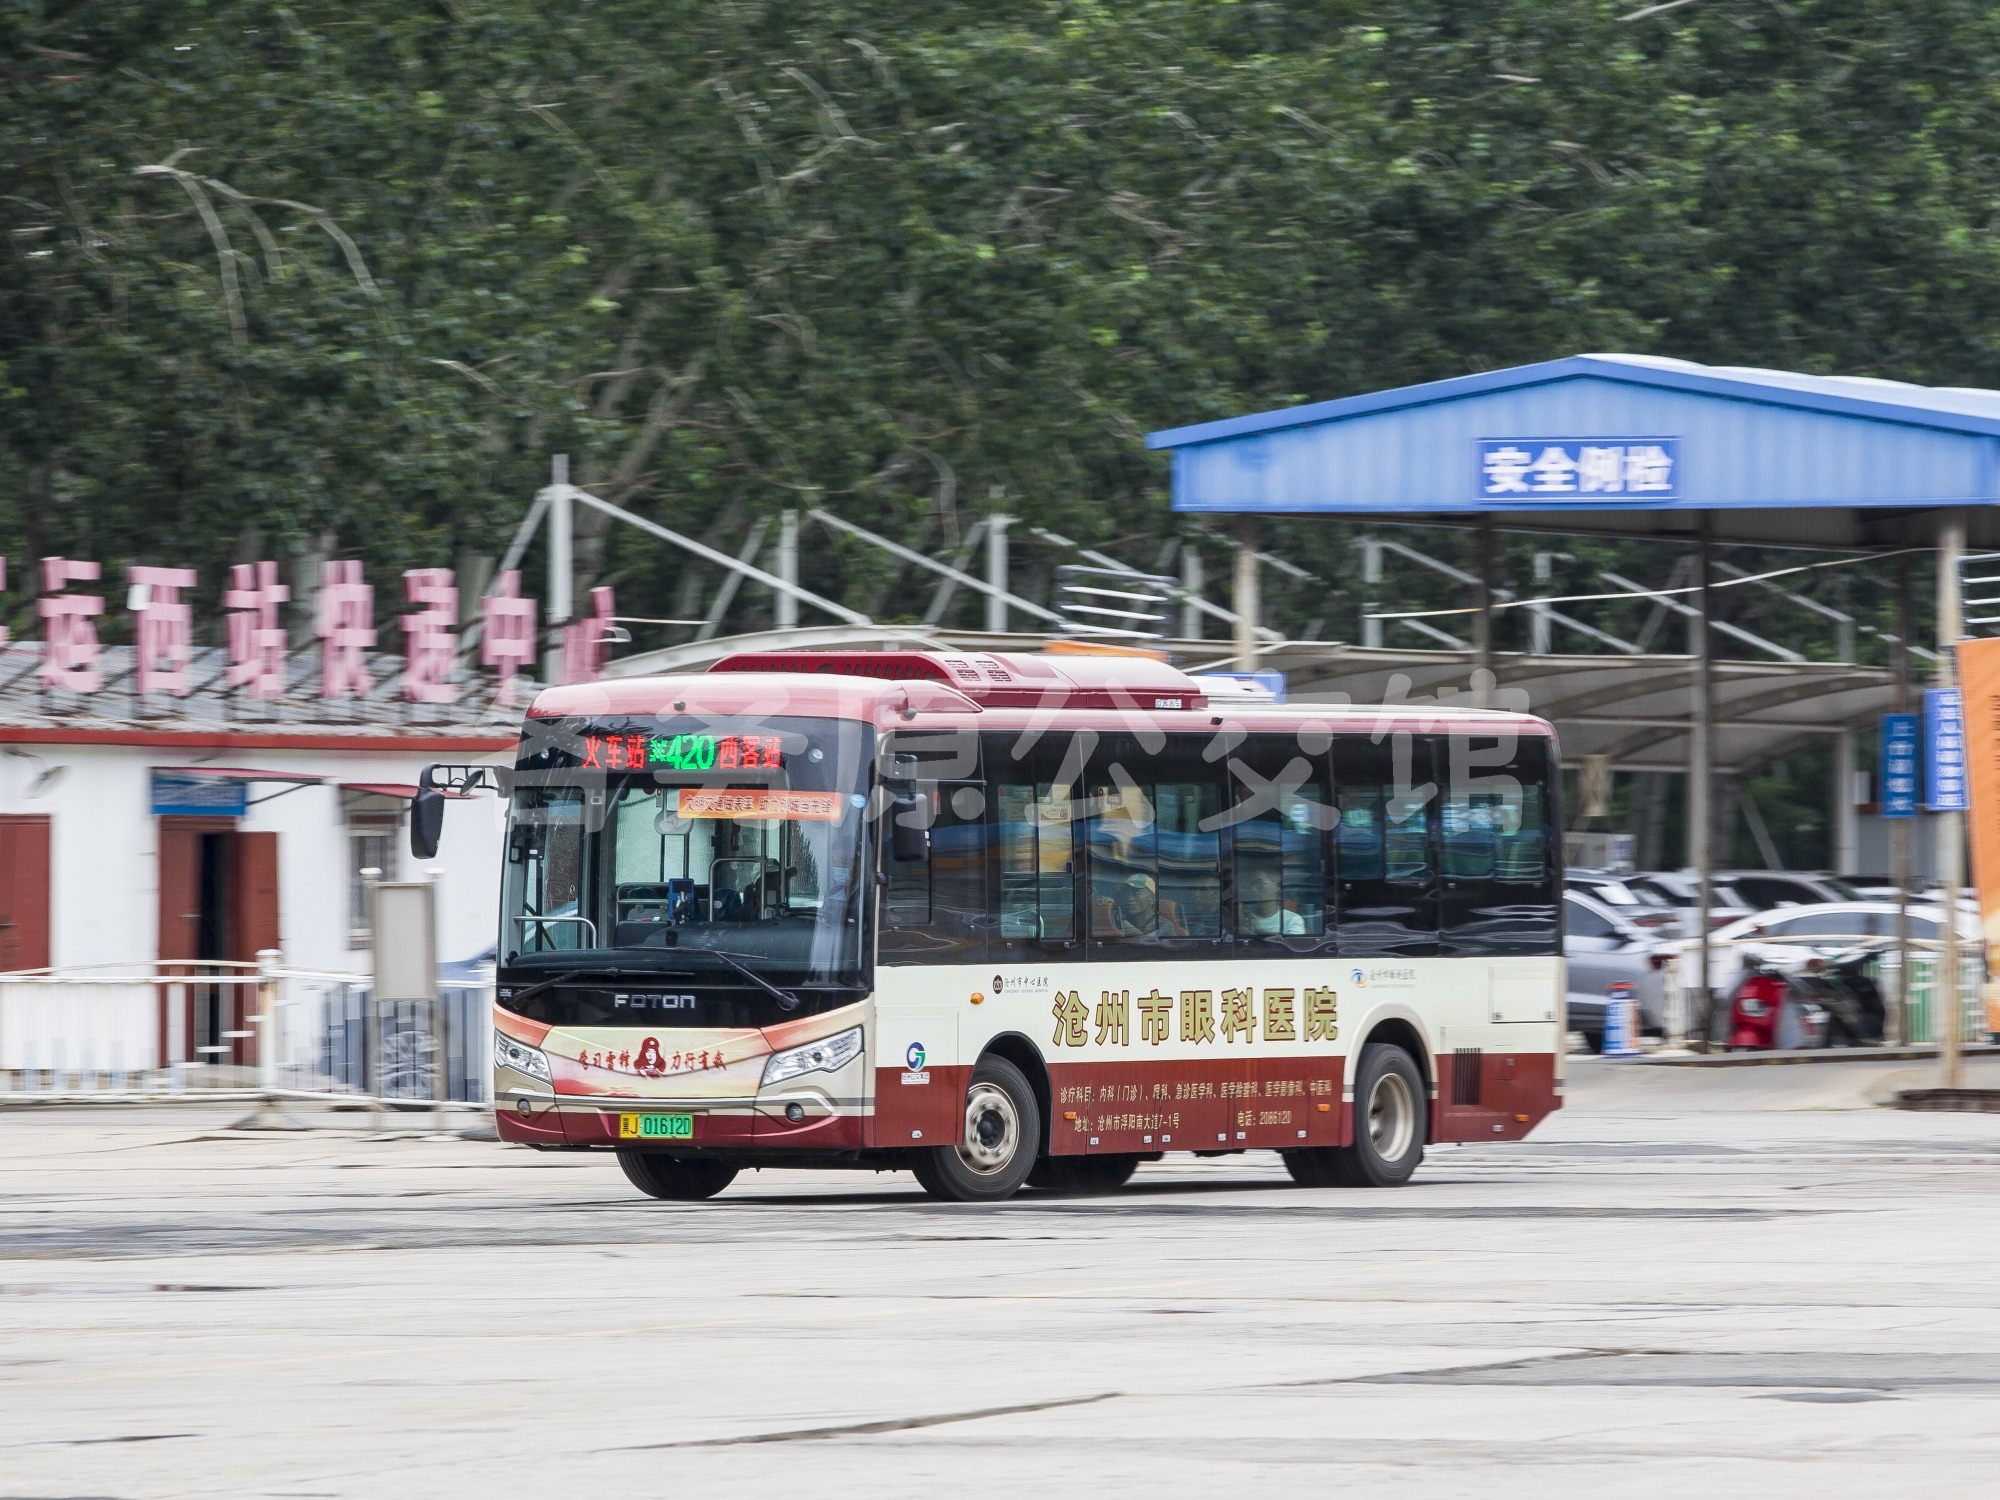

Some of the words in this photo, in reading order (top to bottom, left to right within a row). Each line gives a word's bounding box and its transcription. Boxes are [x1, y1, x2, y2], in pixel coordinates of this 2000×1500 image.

[1482, 445, 1675, 494] 安全例检
[581, 735, 646, 769] 火车站
[667, 735, 714, 769] 420
[719, 735, 782, 769] 西客站
[614, 994, 696, 1009] FOTON
[1052, 986, 1339, 1048] 沧州市眼科医院
